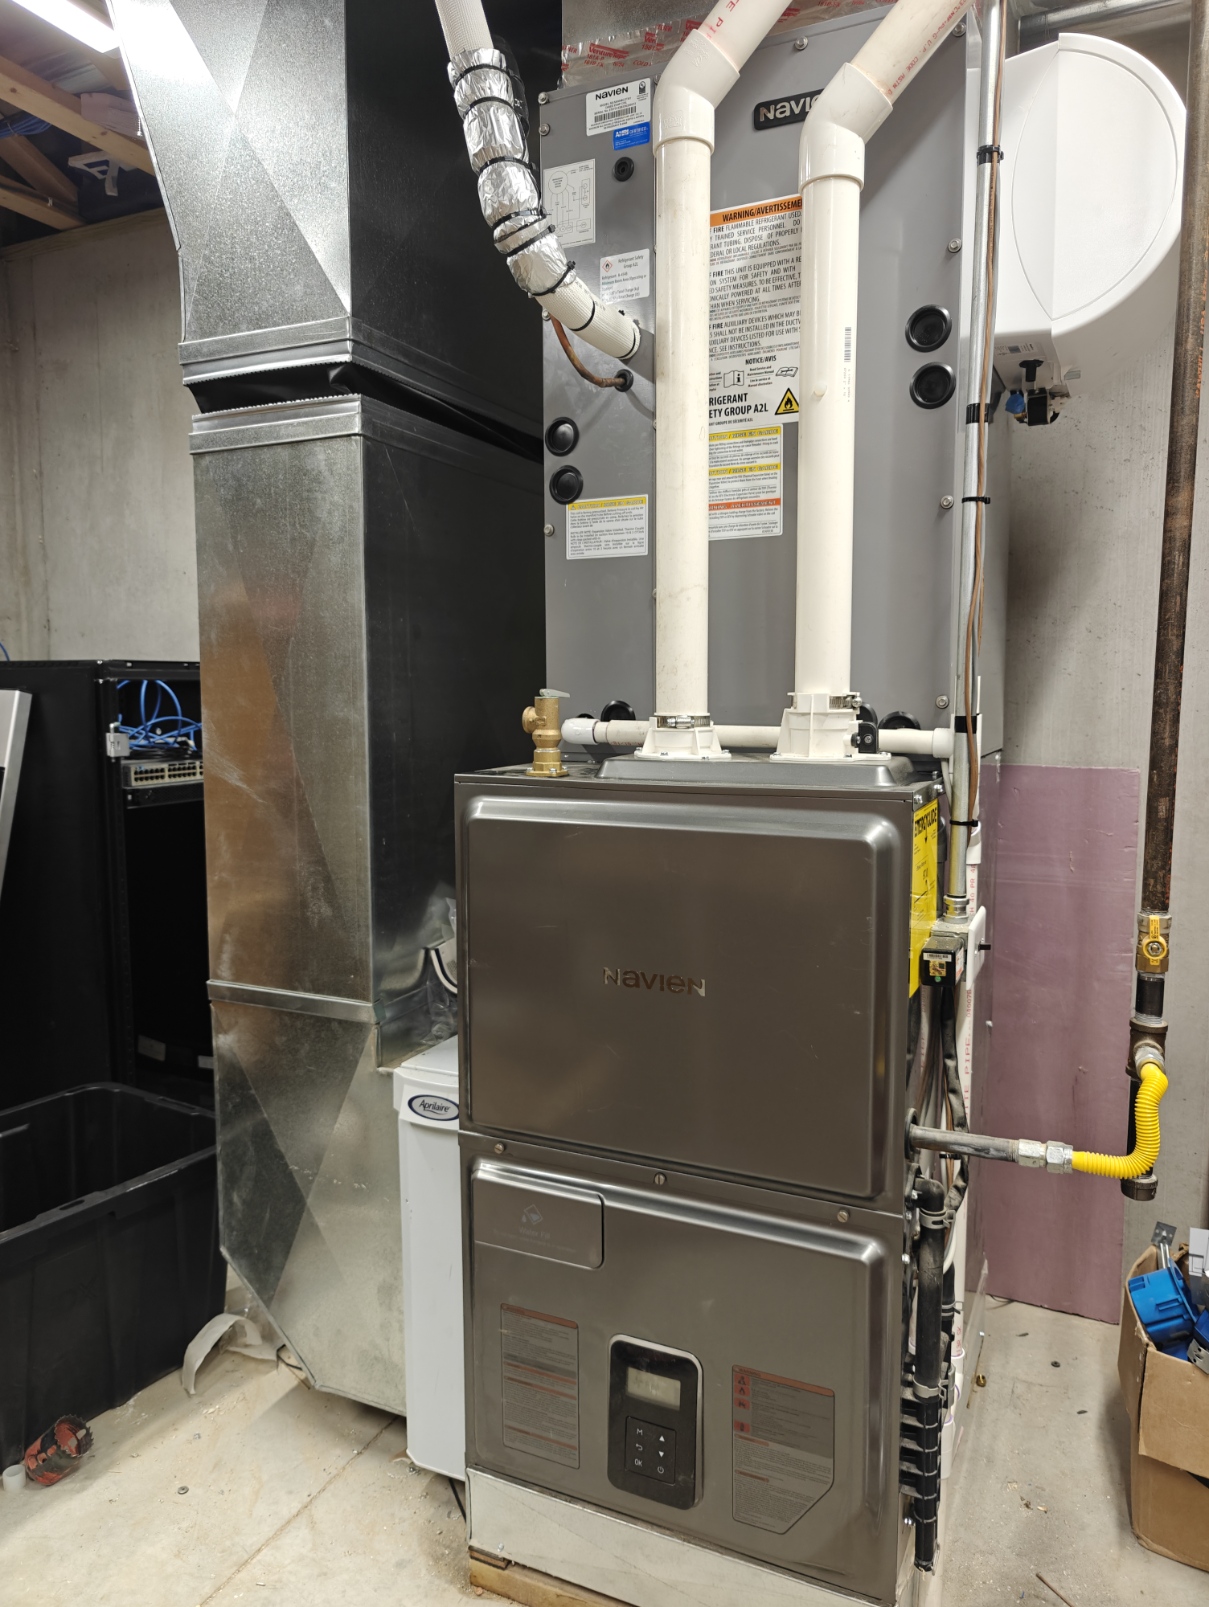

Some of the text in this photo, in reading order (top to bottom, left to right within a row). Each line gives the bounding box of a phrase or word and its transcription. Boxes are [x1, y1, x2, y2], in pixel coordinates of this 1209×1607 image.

[713, 225, 724, 233] FIRE
[725, 219, 754, 231] FLAMMABLE
[756, 215, 787, 227] REFRIGERANT
[710, 241, 722, 250] RANT
[744, 234, 763, 244] DISPOSE
[767, 231, 774, 239] OF
[776, 227, 799, 237] PROPERLY
[715, 231, 734, 241] TRAINED
[737, 228, 756, 237] SERVICE
[713, 270, 723, 278] FIRE
[725, 267, 735, 275] THIS
[736, 265, 748, 273] UNIT
[754, 260, 776, 271] EQUIPPED
[777, 258, 790, 267] WITH
[720, 275, 737, 285] SYSTEM
[740, 273, 749, 281] FOR
[751, 270, 768, 280] SAFETY
[771, 268, 781, 276] AND
[783, 265, 796, 273] WITH
[716, 283, 733, 293] SAFETY
[759, 278, 766, 286] TO
[731, 288, 753, 298] POWERED
[762, 284, 771, 293] ALL
[772, 282, 786, 291] TIMES
[710, 301, 720, 309] HAN
[721, 299, 735, 307] WHEN
[713, 322, 724, 330] FIRE
[724, 317, 748, 328] AUXILIARY
[748, 314, 767, 324] DEVICES
[768, 312, 784, 321] WHICH
[785, 310, 796, 318] MAY
[709, 325, 798, 346] UXILIARY DEVICES LISTED FOR USE WITH
[713, 330, 728, 338] SHALL
[729, 327, 738, 335] NOT
[745, 321, 769, 332] INSTALLED
[770, 320, 776, 328] IN
[776, 319, 785, 327] THE
[709, 393, 748, 406] RIGERANT
[709, 402, 769, 419] ETY GROUP A2L
[419, 1099, 451, 1113] Aprilaire
[636, 1428, 643, 1436] M
[634, 1458, 643, 1467] OK
